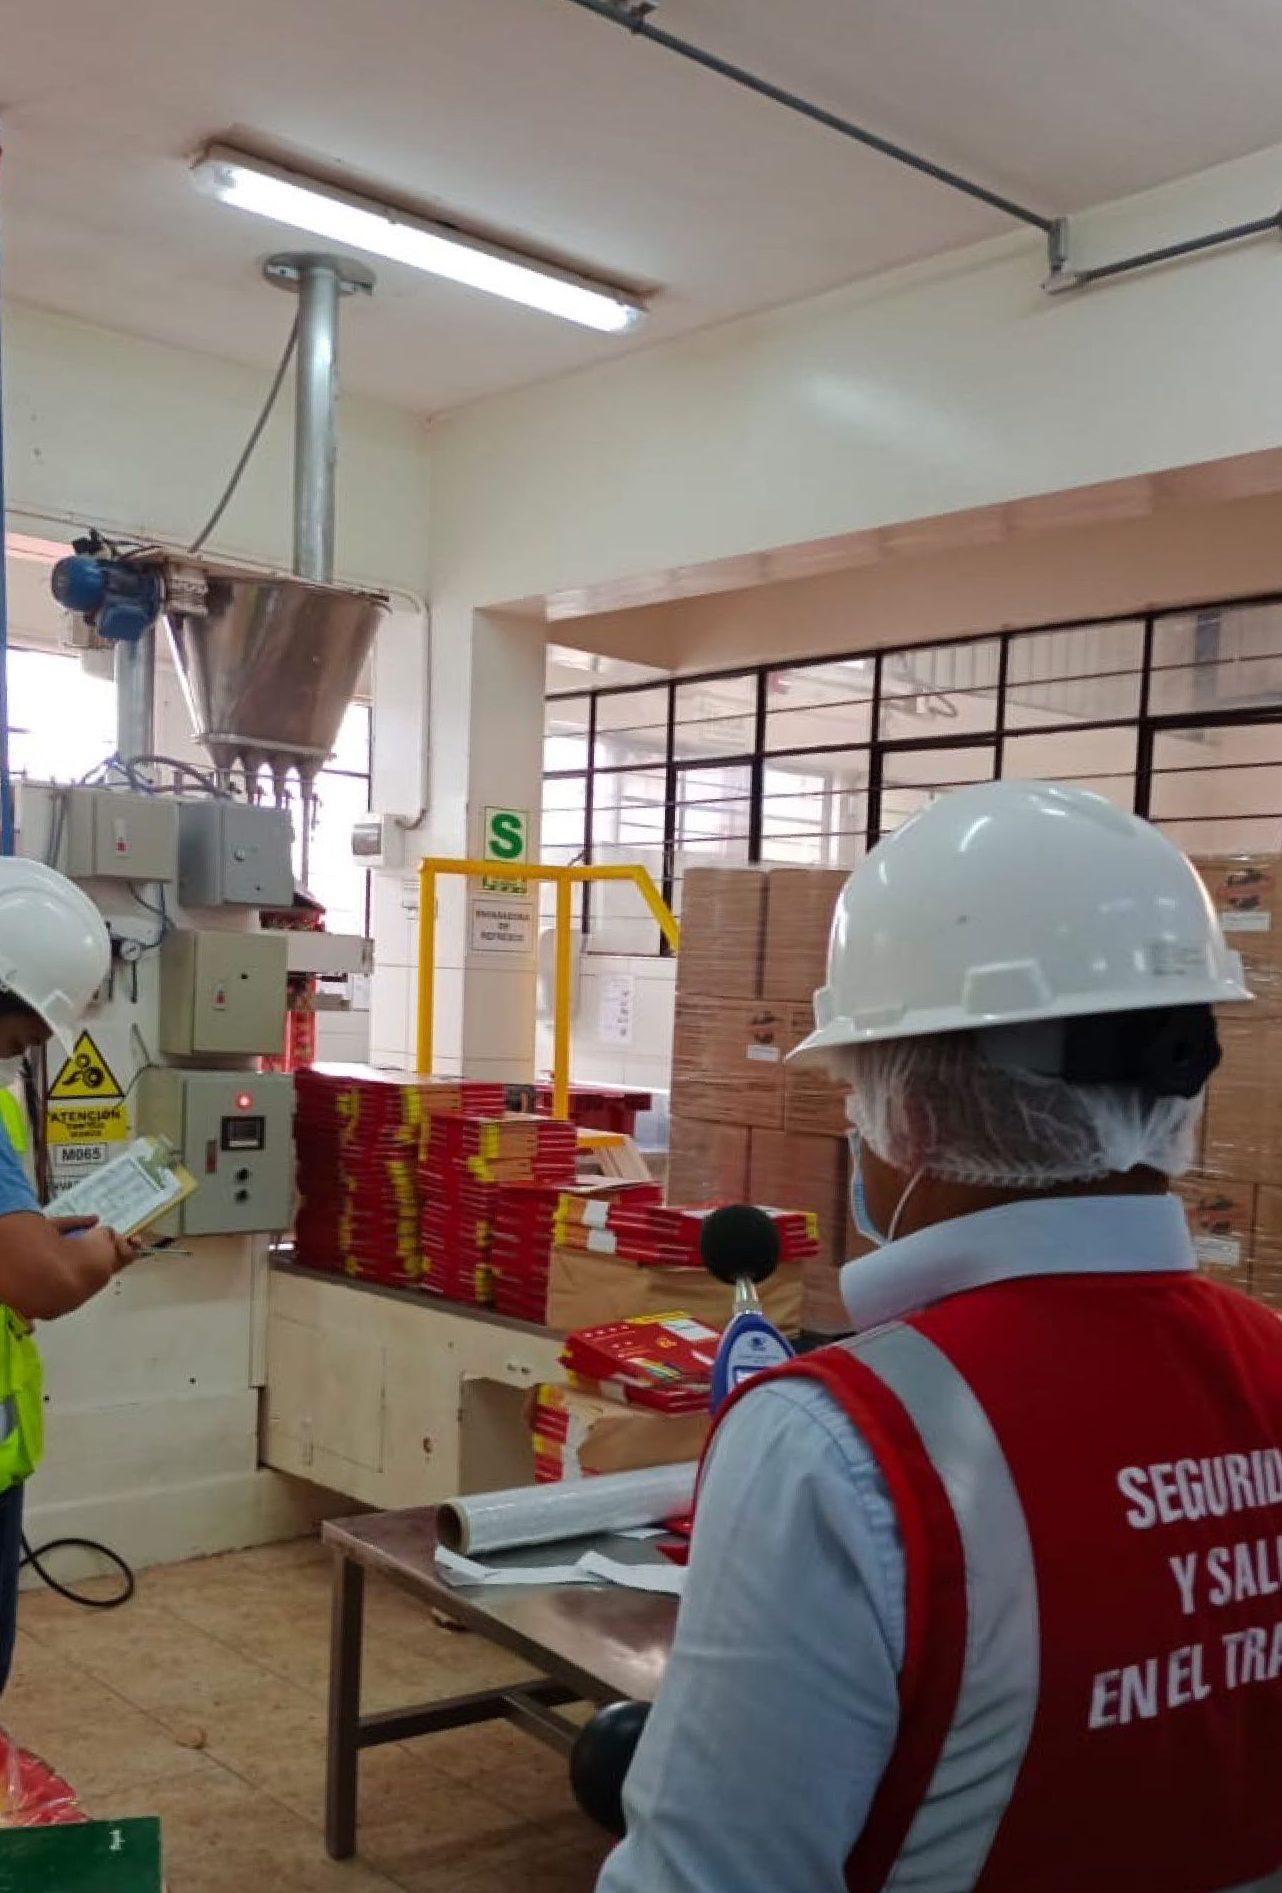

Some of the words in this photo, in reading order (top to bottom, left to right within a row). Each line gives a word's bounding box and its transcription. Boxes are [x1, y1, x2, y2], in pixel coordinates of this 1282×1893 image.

[488, 813, 523, 859] S
[62, 1147, 101, 1162] M065
[1169, 1553, 1197, 1615] Y
[1207, 1535, 1282, 1606] SAL
[1089, 1658, 1158, 1729] EN
[1167, 1644, 1212, 1709] EL
